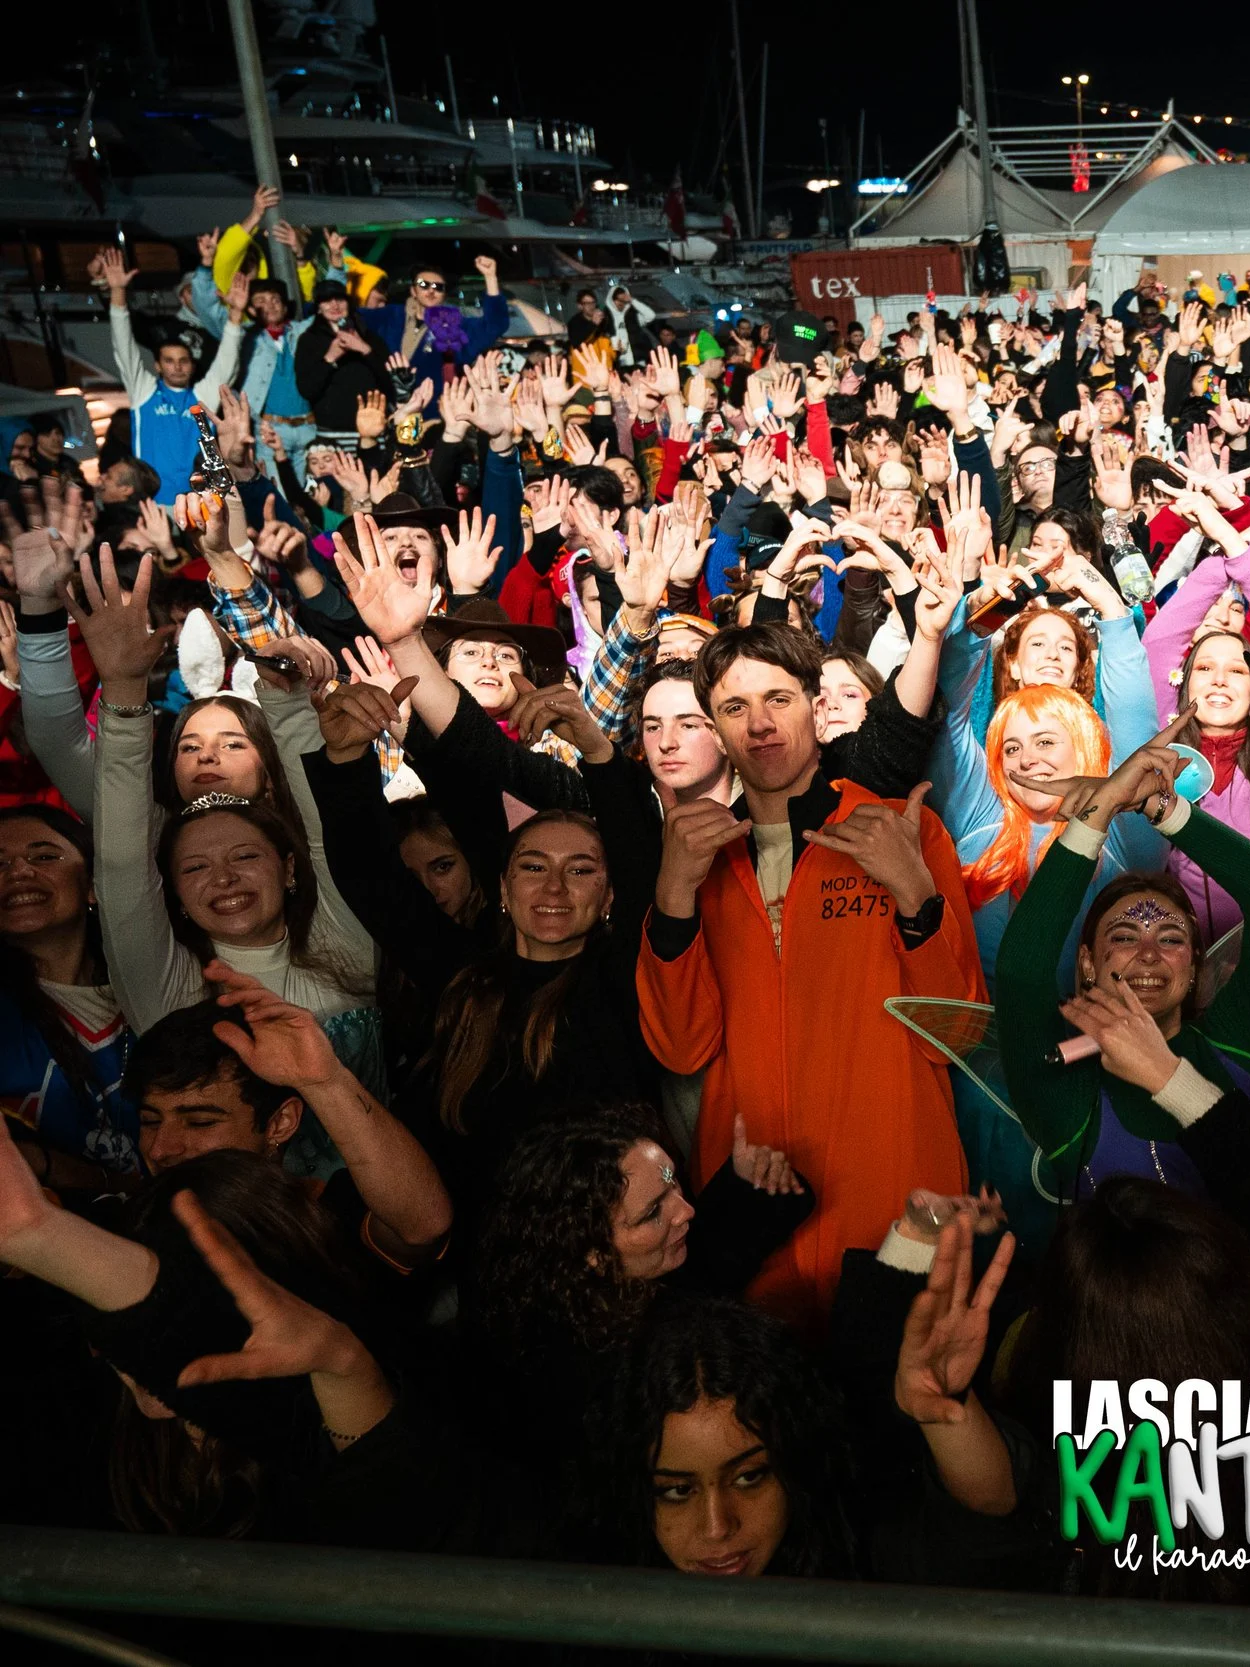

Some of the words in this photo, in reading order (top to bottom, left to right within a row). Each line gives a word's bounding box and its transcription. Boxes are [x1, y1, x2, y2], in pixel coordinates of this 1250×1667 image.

[810, 273, 862, 299] tex
[821, 876, 858, 893] MOD
[821, 894, 890, 920] 82475
